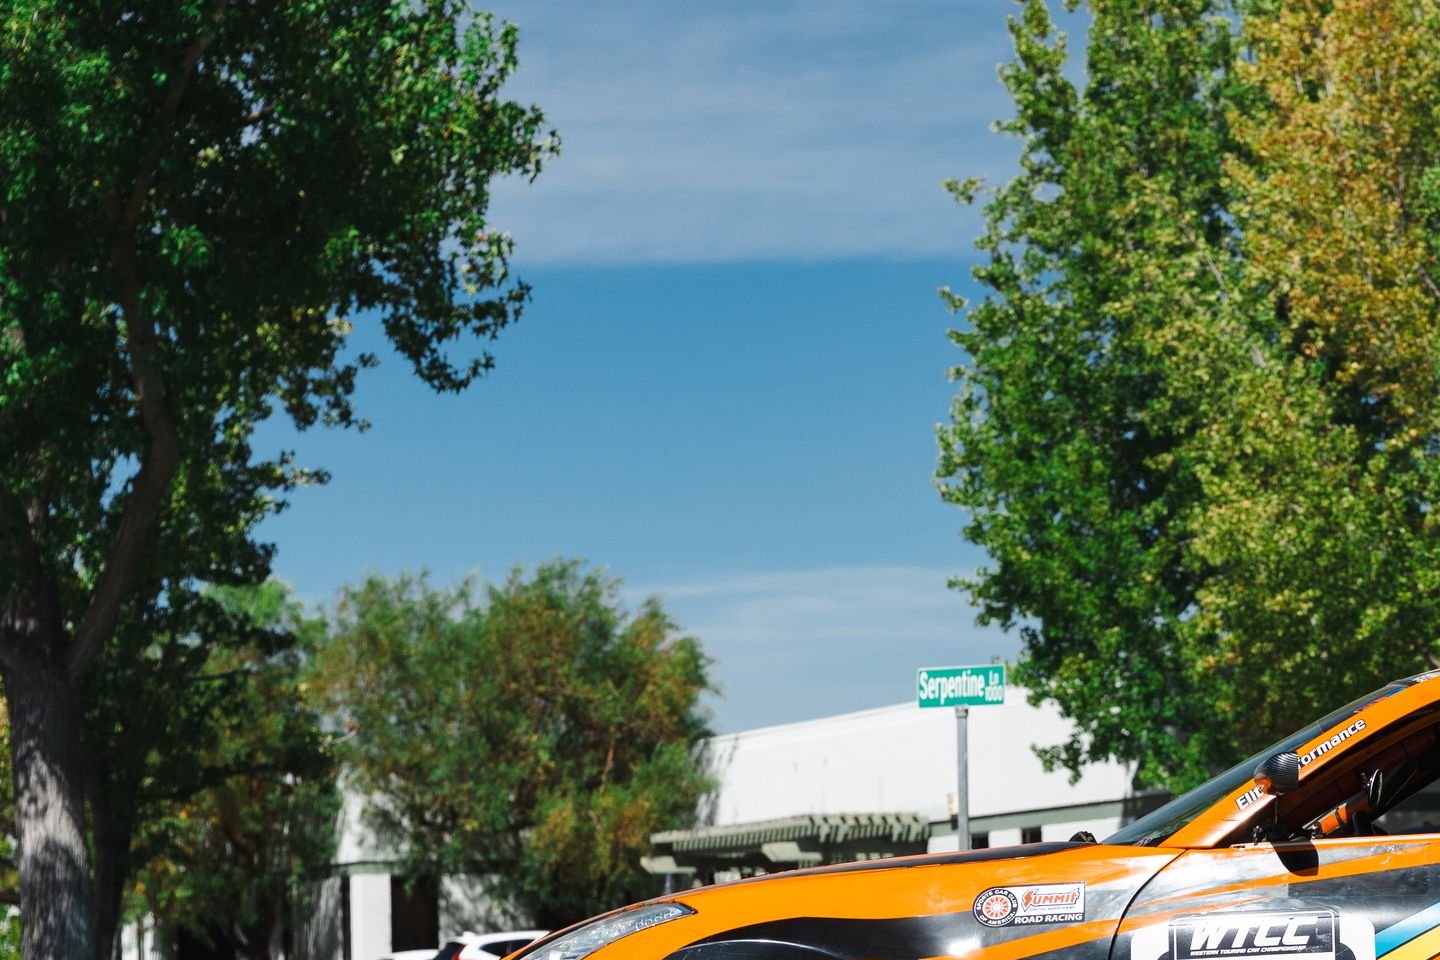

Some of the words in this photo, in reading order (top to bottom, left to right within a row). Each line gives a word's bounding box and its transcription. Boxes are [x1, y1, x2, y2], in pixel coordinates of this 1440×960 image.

[919, 670, 985, 705] Serpentine
[1235, 784, 1265, 810] Elit
[1014, 915, 1043, 924] ROAD
[1045, 913, 1083, 923] RACING
[1189, 916, 1319, 950] WTCC
